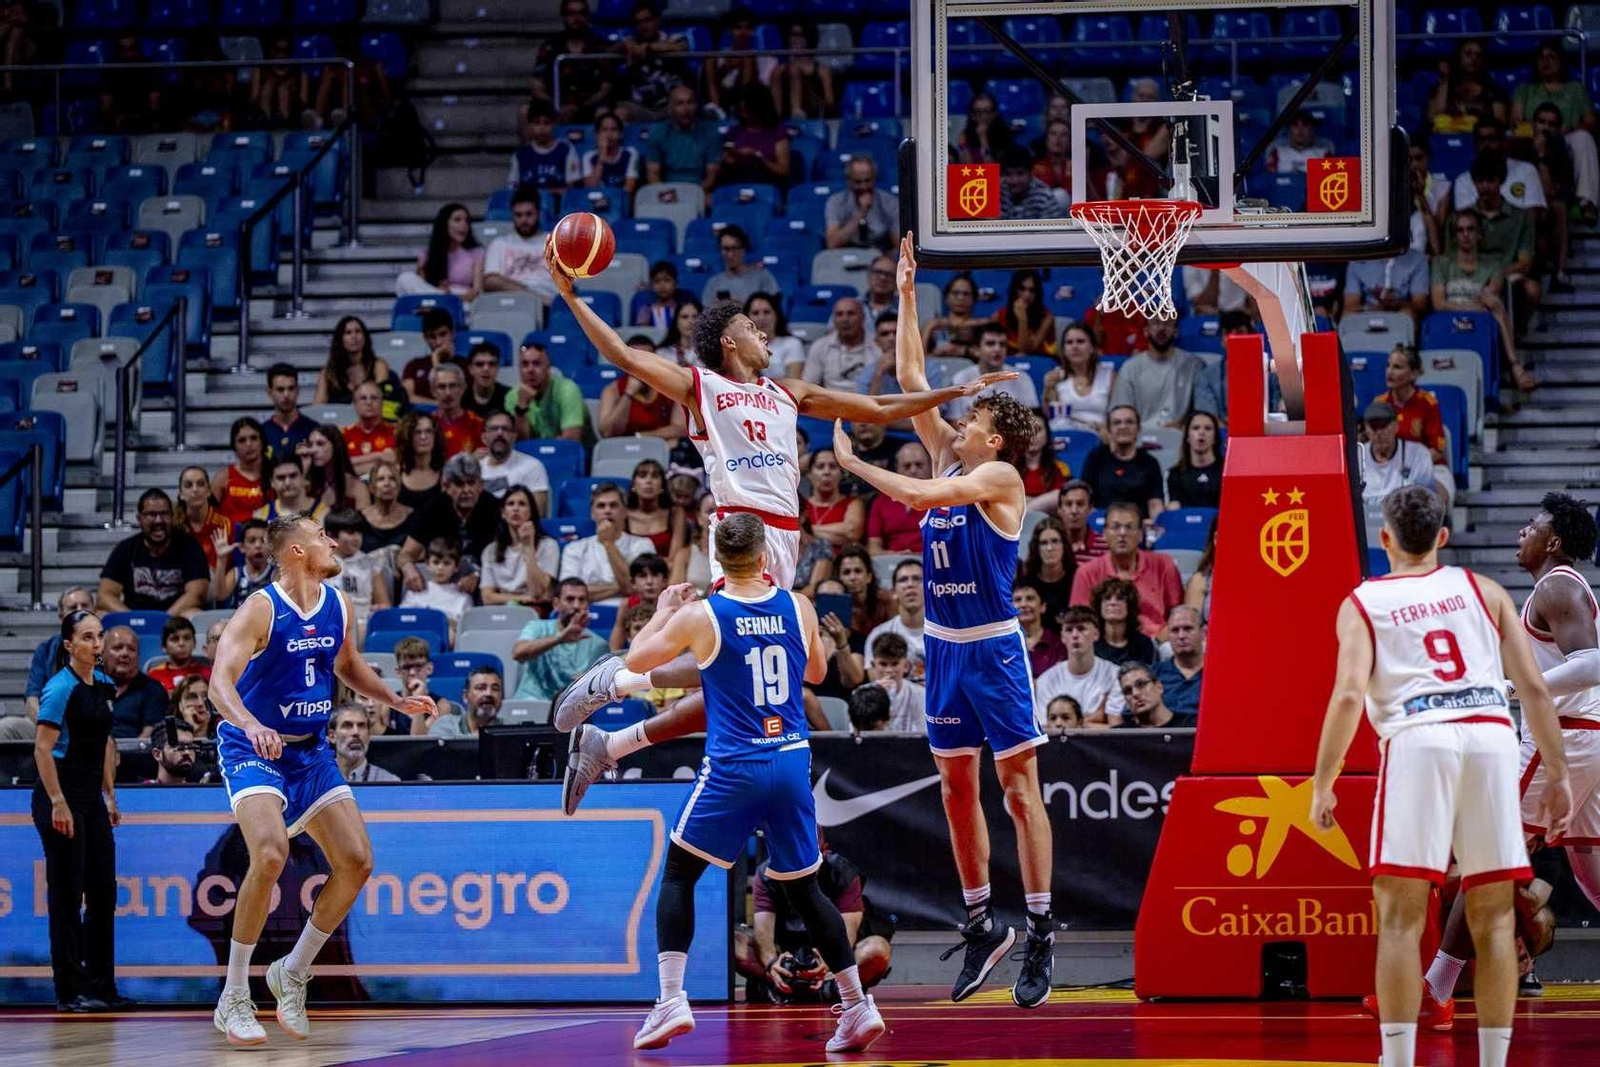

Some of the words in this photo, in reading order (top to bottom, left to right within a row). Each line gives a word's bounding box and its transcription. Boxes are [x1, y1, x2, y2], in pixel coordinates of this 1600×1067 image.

[716, 391, 779, 415] ESPAÑA
[743, 419, 766, 442] 13
[1288, 512, 1304, 520] FEB
[930, 541, 950, 569] 11
[1391, 594, 1466, 626] FERRANDO
[735, 615, 786, 636] SEHNAL
[286, 636, 335, 652] ČESKO
[1423, 629, 1466, 682] 9
[305, 658, 316, 687] 5
[744, 644, 790, 707] 19
[1428, 688, 1501, 709] CaixaBank
[1003, 769, 1177, 820] nde
[364, 871, 570, 930] negro
